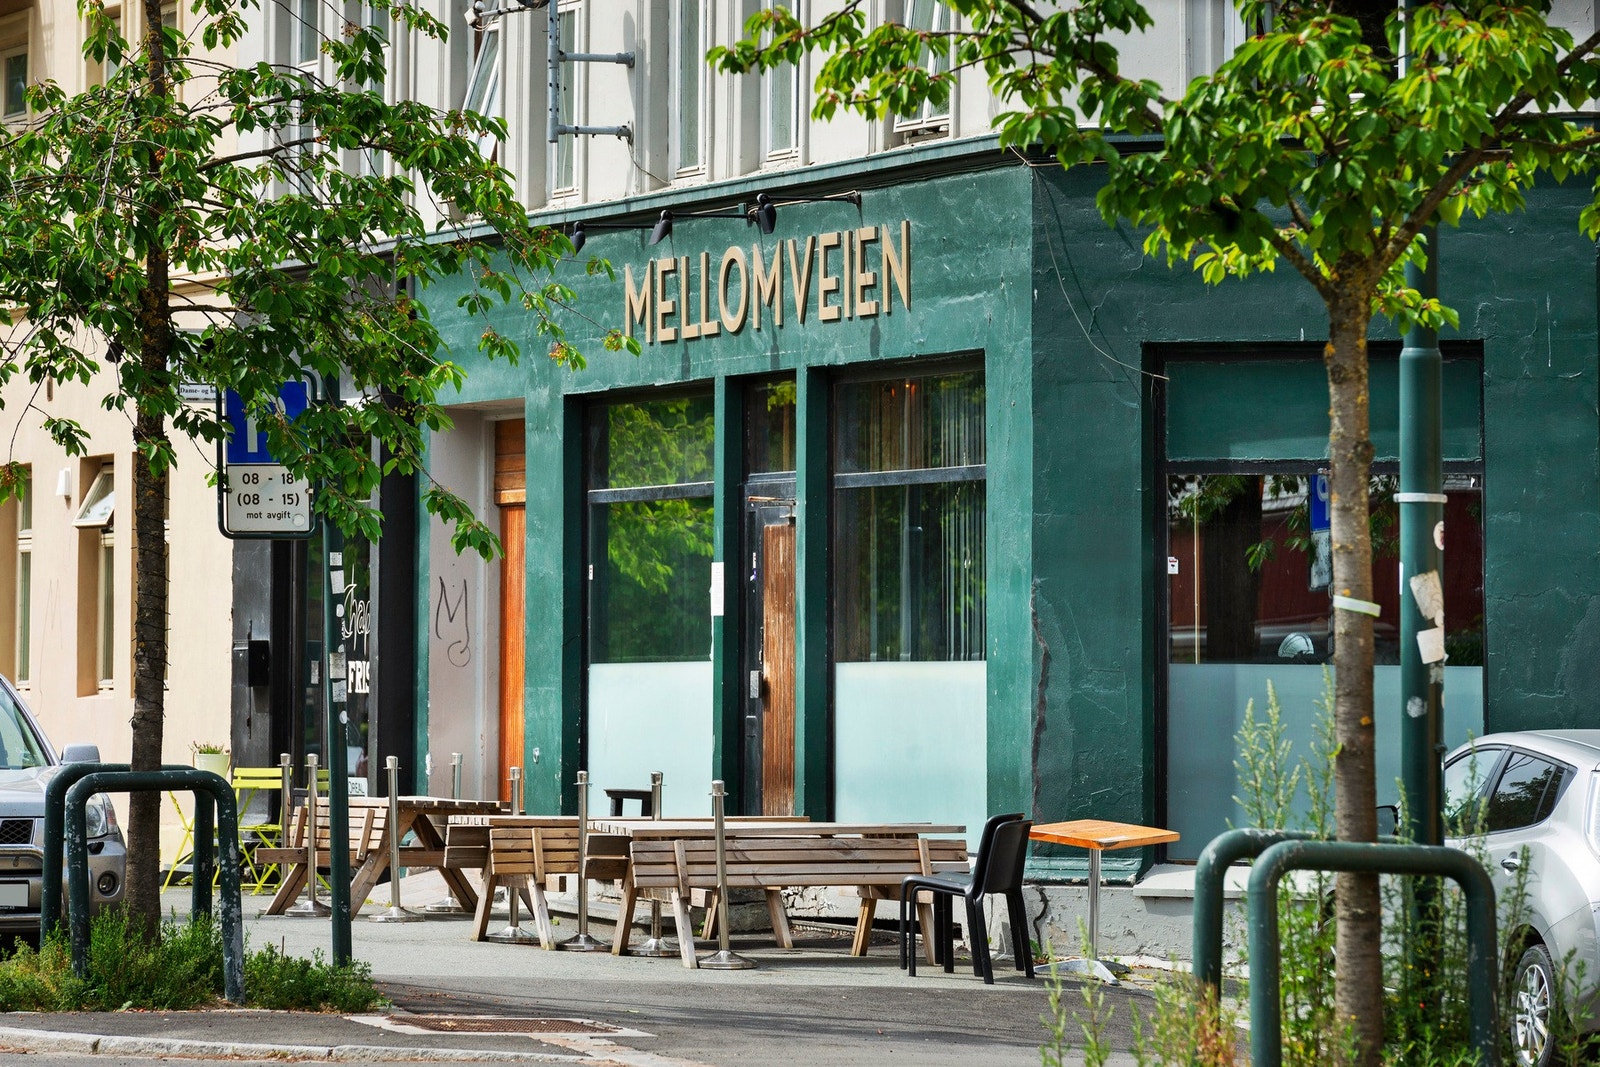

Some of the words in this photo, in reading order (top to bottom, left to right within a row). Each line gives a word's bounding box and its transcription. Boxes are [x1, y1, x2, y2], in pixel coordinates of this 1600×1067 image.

[624, 220, 911, 343] MELLOMVEIEN
[242, 473, 259, 485] 08
[281, 473, 294, 485] 18
[237, 492, 260, 507] (08
[282, 492, 300, 507] 15)
[246, 511, 262, 519] mot
[266, 511, 291, 521] avgift
